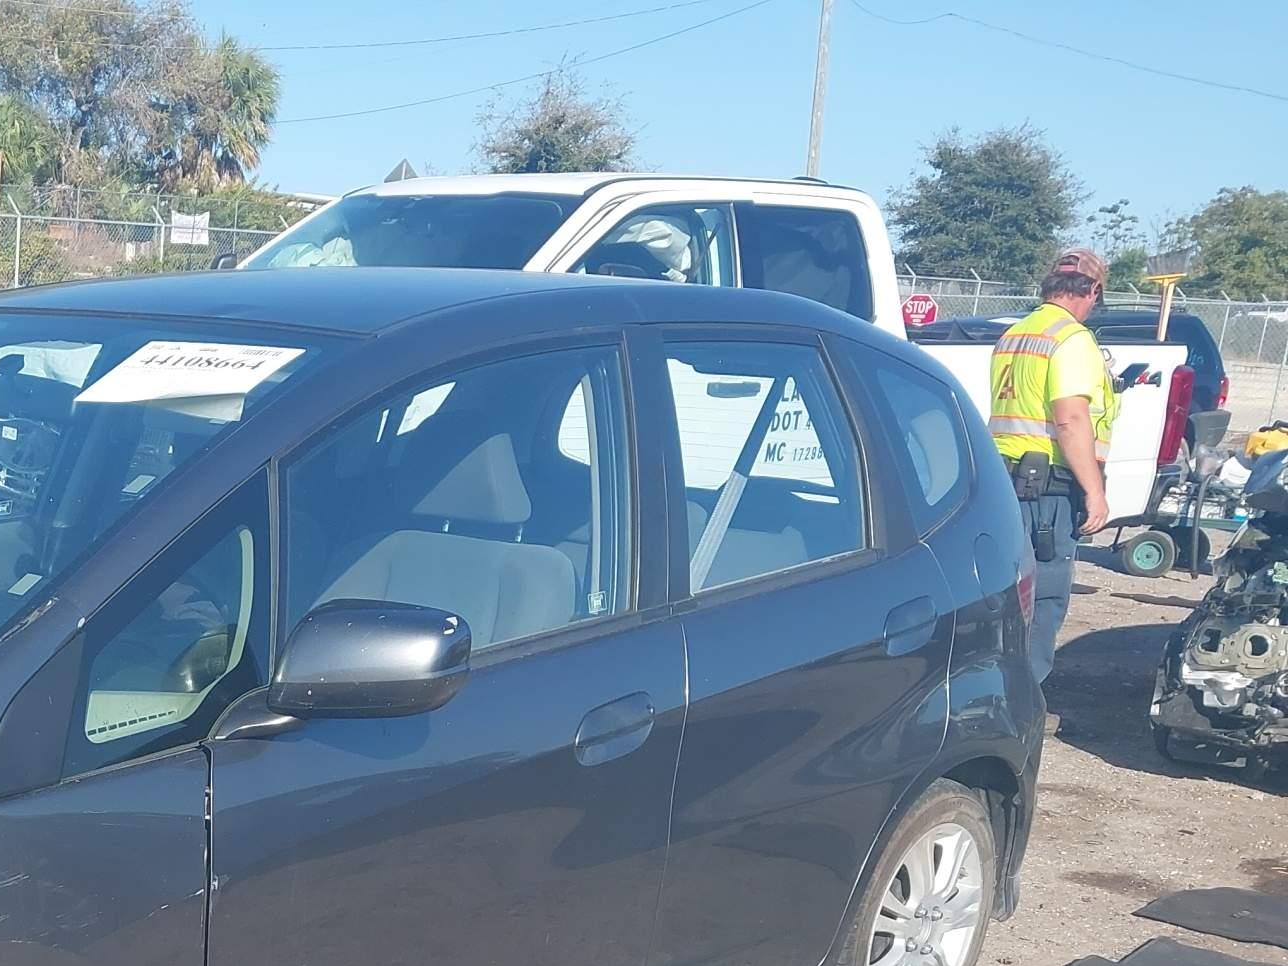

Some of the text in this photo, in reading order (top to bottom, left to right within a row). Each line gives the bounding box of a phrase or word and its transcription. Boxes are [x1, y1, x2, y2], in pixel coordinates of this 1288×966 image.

[905, 300, 934, 314] STOP
[140, 354, 266, 370] 44108664
[771, 411, 803, 432] DOT
[765, 442, 787, 463] MC
